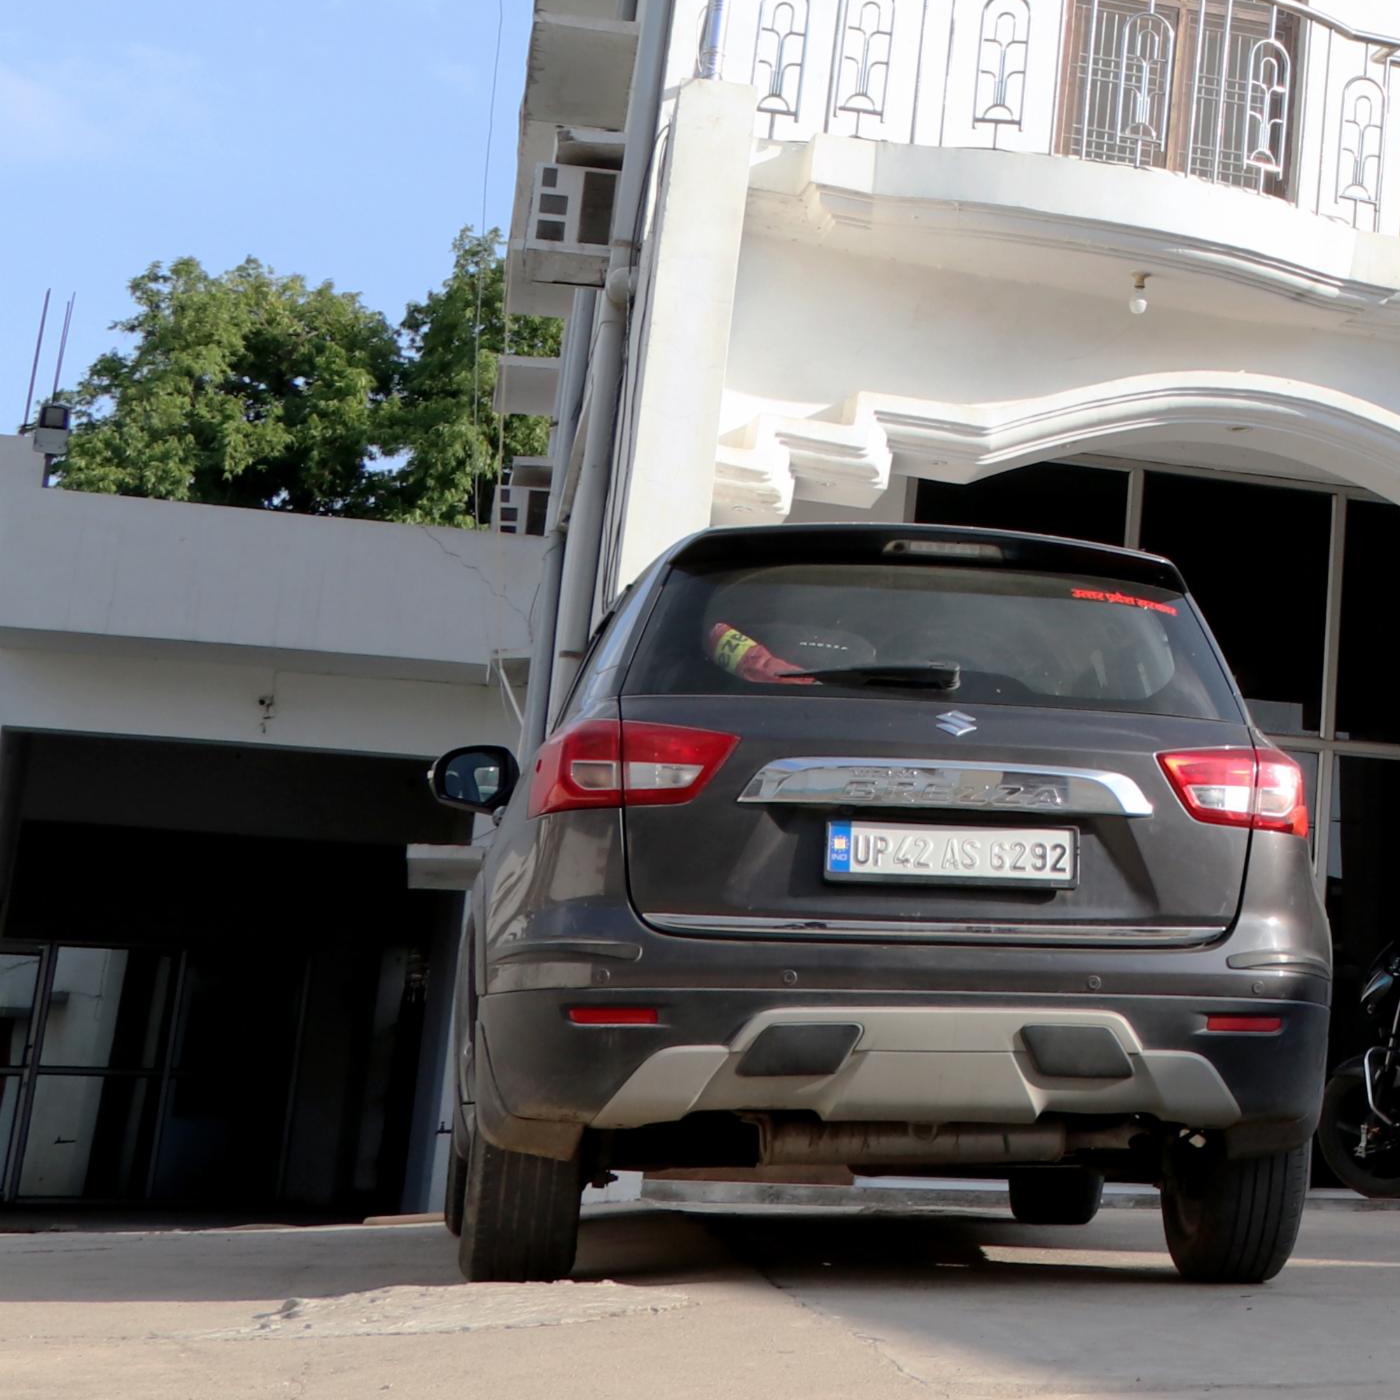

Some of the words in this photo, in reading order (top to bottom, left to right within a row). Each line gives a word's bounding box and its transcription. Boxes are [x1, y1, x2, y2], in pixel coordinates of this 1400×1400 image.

[838, 778, 1064, 806] BREZZA
[941, 838, 980, 870] AS
[989, 841, 1068, 873] 6292
